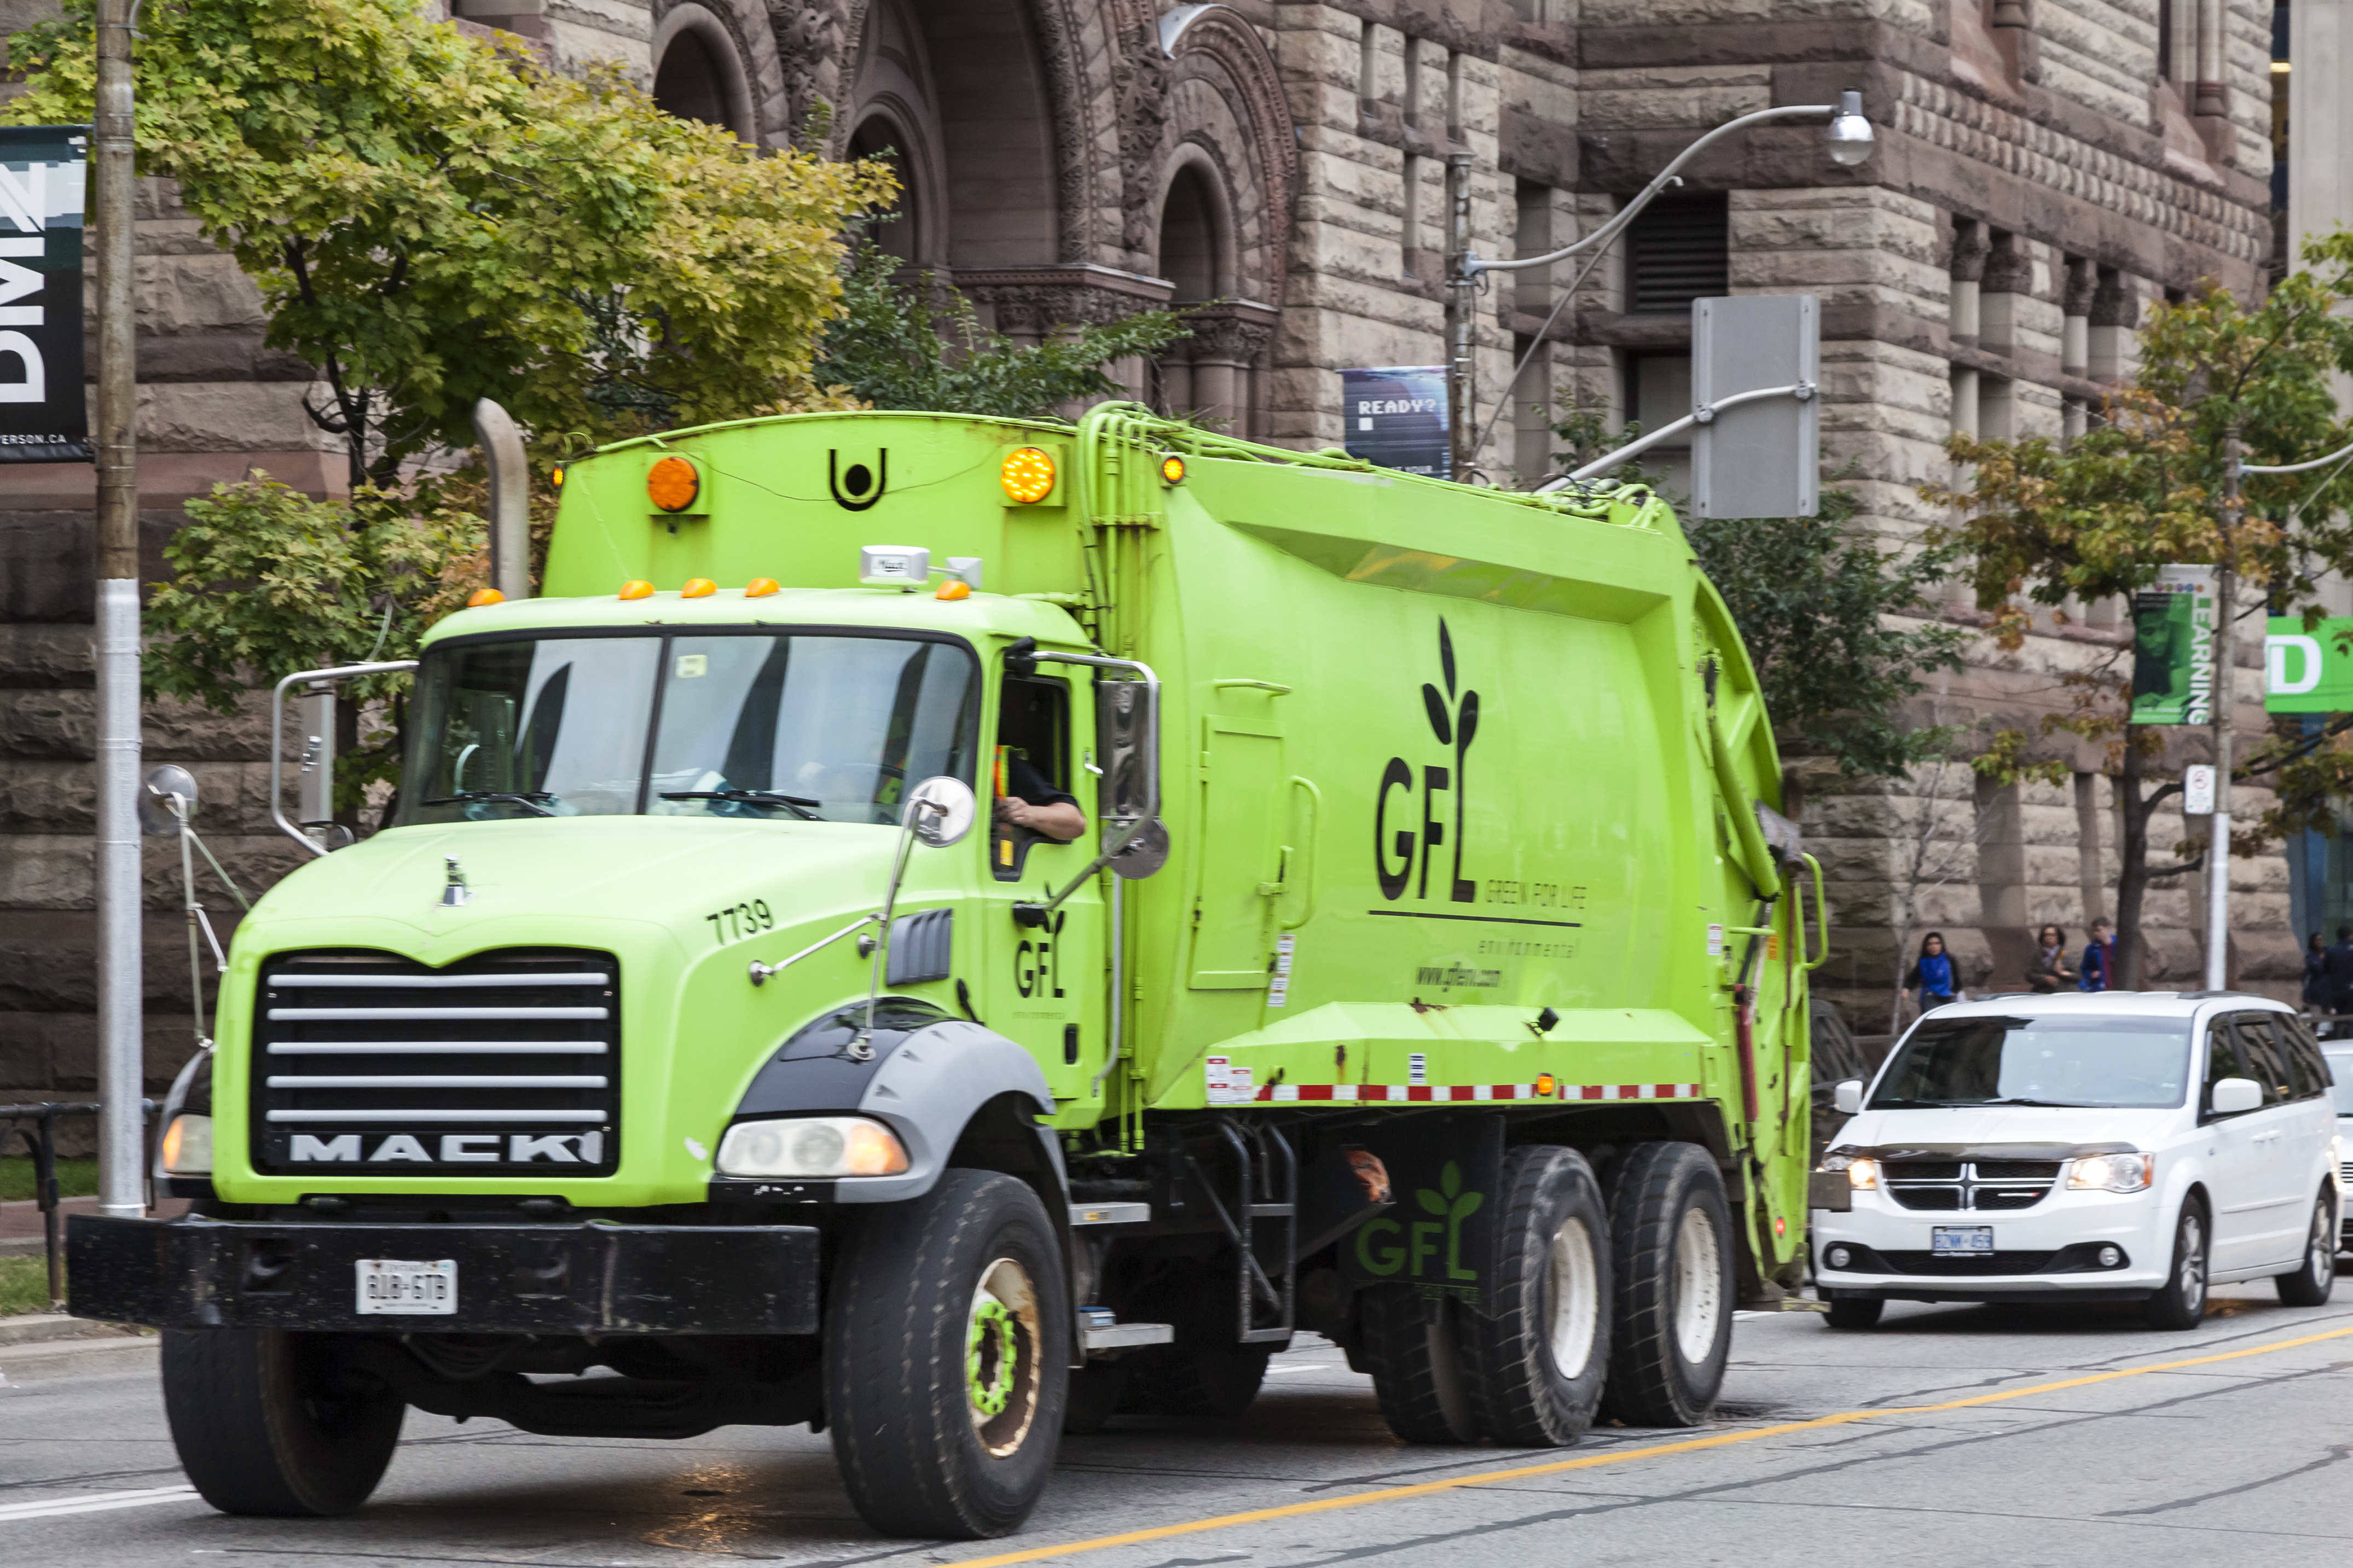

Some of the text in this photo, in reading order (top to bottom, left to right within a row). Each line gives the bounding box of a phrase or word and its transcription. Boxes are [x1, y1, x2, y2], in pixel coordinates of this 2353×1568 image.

[1359, 399, 1436, 414] READY?
[0, 434, 67, 445] ERSON.CA
[2188, 593, 2212, 725] LEARNING
[2265, 635, 2323, 694] D
[1375, 690, 1480, 903] GFL
[704, 898, 774, 945] 7739
[1013, 910, 1066, 998] GFL
[290, 1135, 581, 1162] MACK
[1355, 1192, 1485, 1281] GFL
